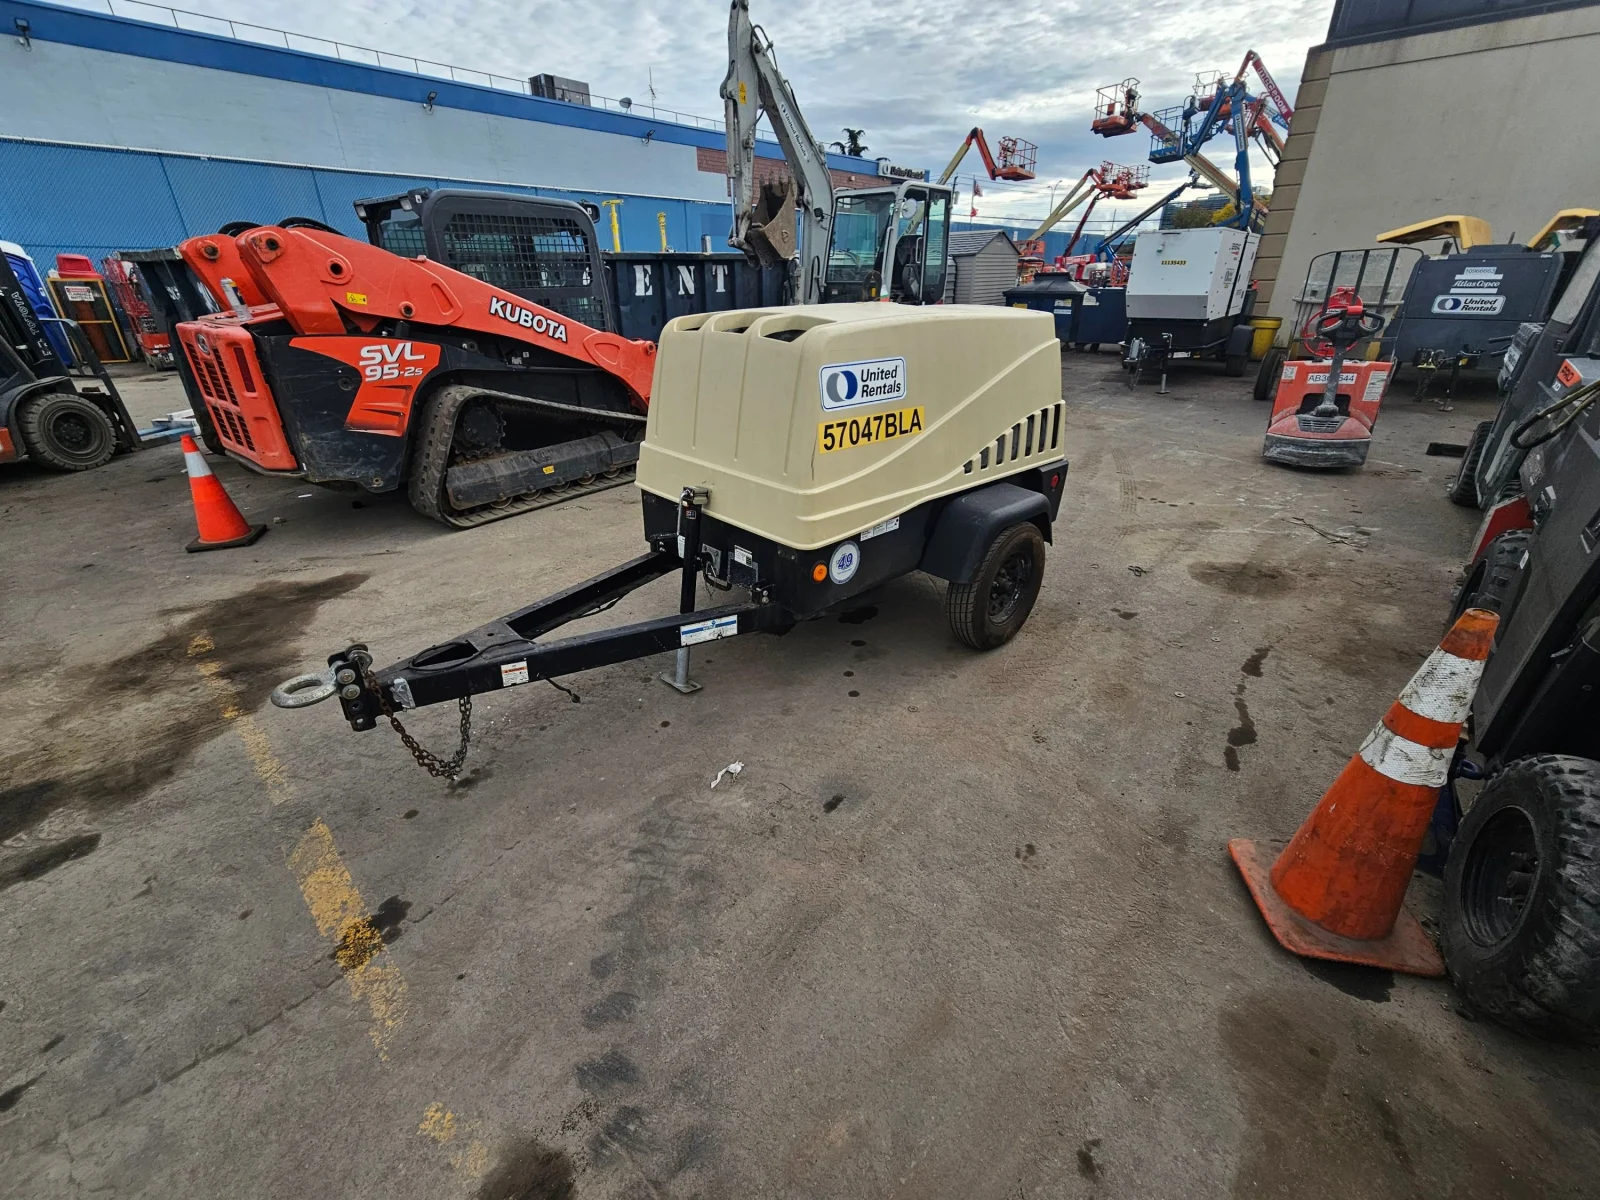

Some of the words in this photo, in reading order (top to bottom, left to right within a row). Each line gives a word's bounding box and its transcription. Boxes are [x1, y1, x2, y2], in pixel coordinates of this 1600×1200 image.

[785, 113, 797, 134] United
[795, 134, 807, 156] Rentals
[1452, 280, 1477, 288] Atlas
[1476, 280, 1501, 288] Copco
[11, 291, 40, 336] TOYOTA
[489, 296, 568, 343] KUBOTA
[359, 342, 426, 366] SVL
[860, 365, 899, 382] United
[861, 380, 902, 398] Rentals
[823, 408, 922, 451] 57047BLA
